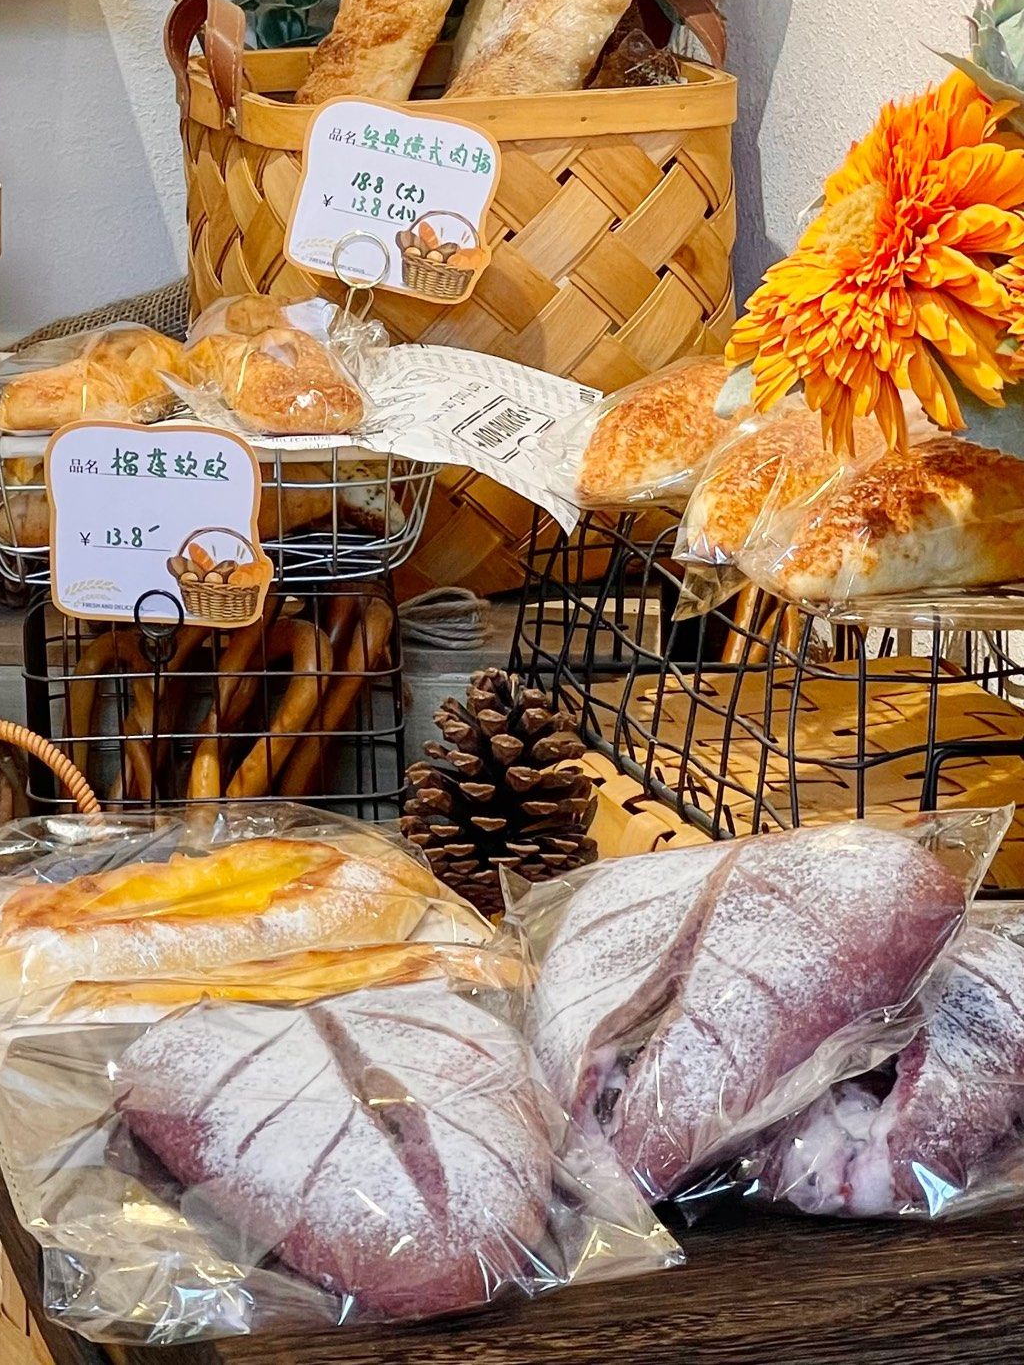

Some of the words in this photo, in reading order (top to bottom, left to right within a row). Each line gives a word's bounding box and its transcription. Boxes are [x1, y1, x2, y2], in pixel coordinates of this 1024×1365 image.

[328, 127, 356, 145] 品名
[351, 172, 384, 194] 18.8
[351, 195, 382, 217] 13.8
[69, 459, 99, 475] 品名
[111, 447, 230, 481] 榴莲软欧
